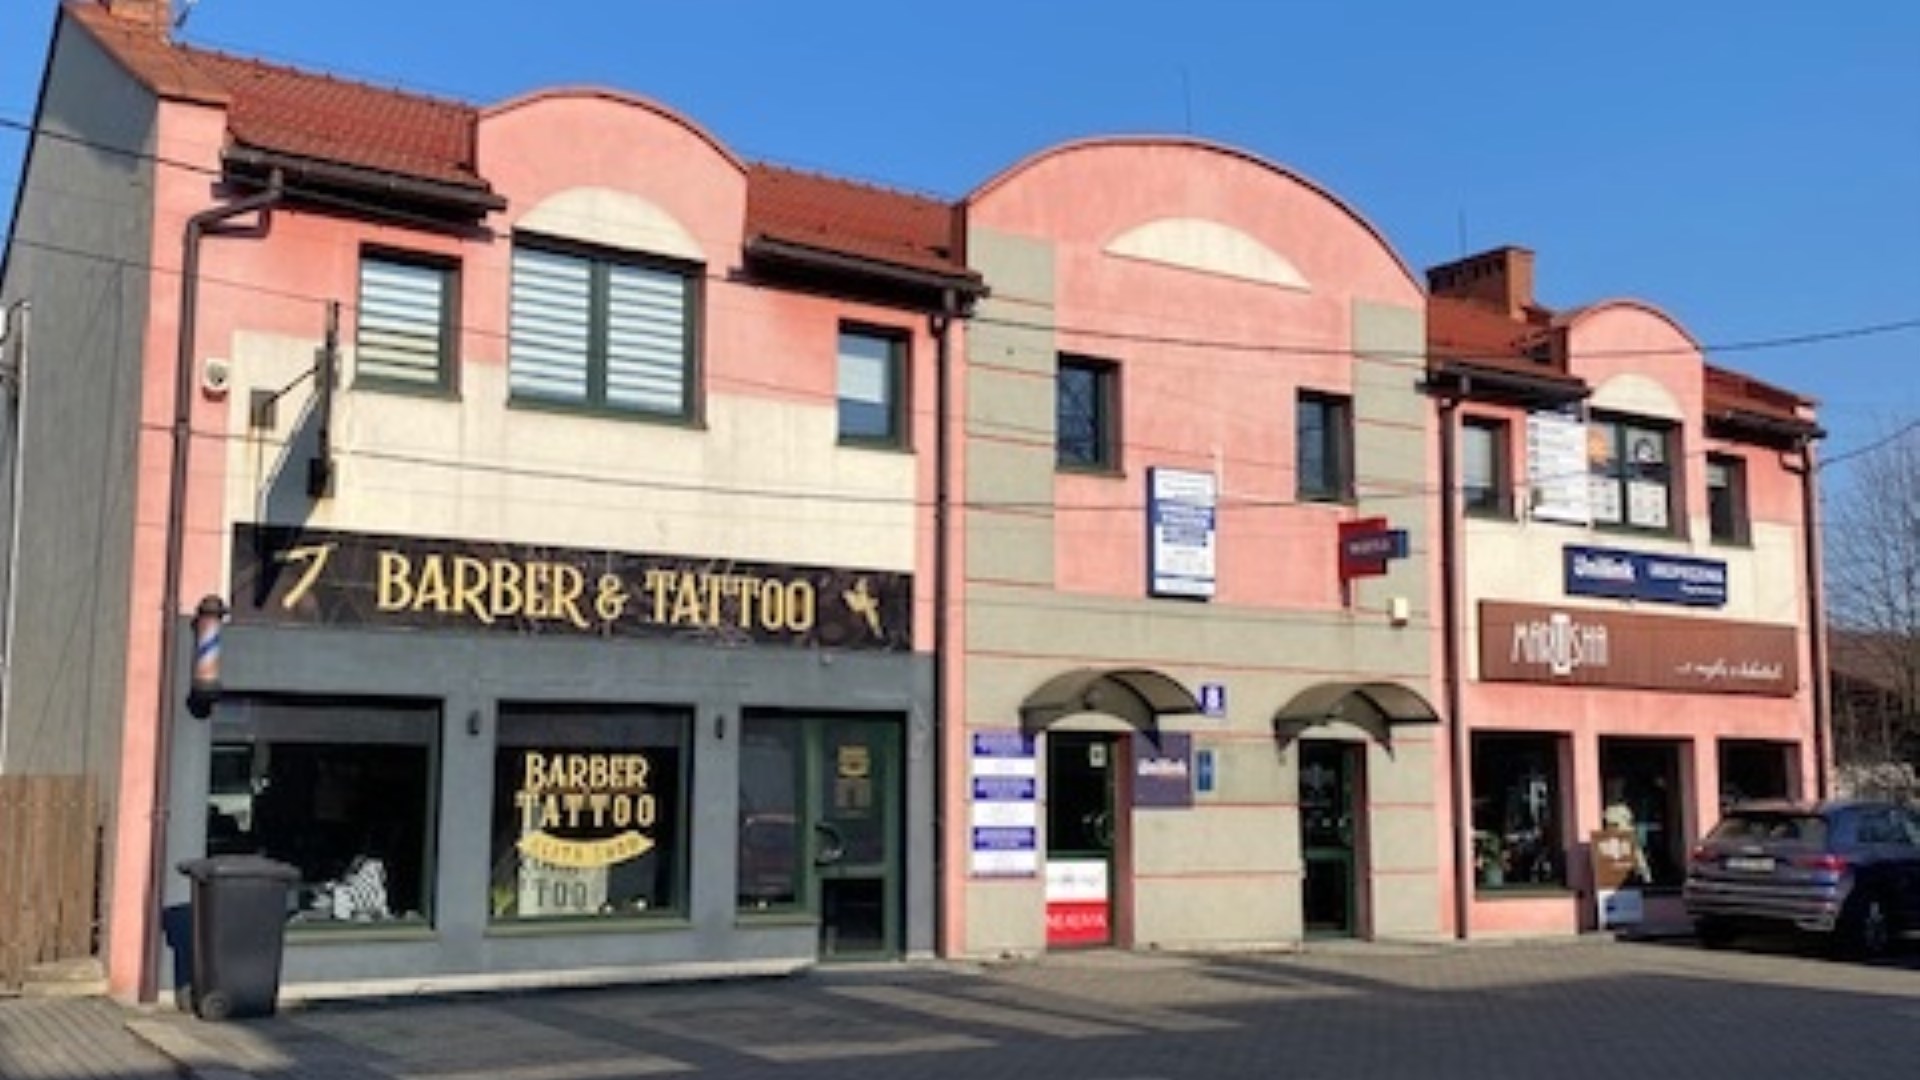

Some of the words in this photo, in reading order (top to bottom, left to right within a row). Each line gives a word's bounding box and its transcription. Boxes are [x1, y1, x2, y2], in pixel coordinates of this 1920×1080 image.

[377, 550, 590, 628] BARBER
[595, 572, 629, 620] &
[644, 568, 816, 633] TATTOO
[524, 751, 650, 789] BARBER
[514, 789, 656, 828] TATTOO
